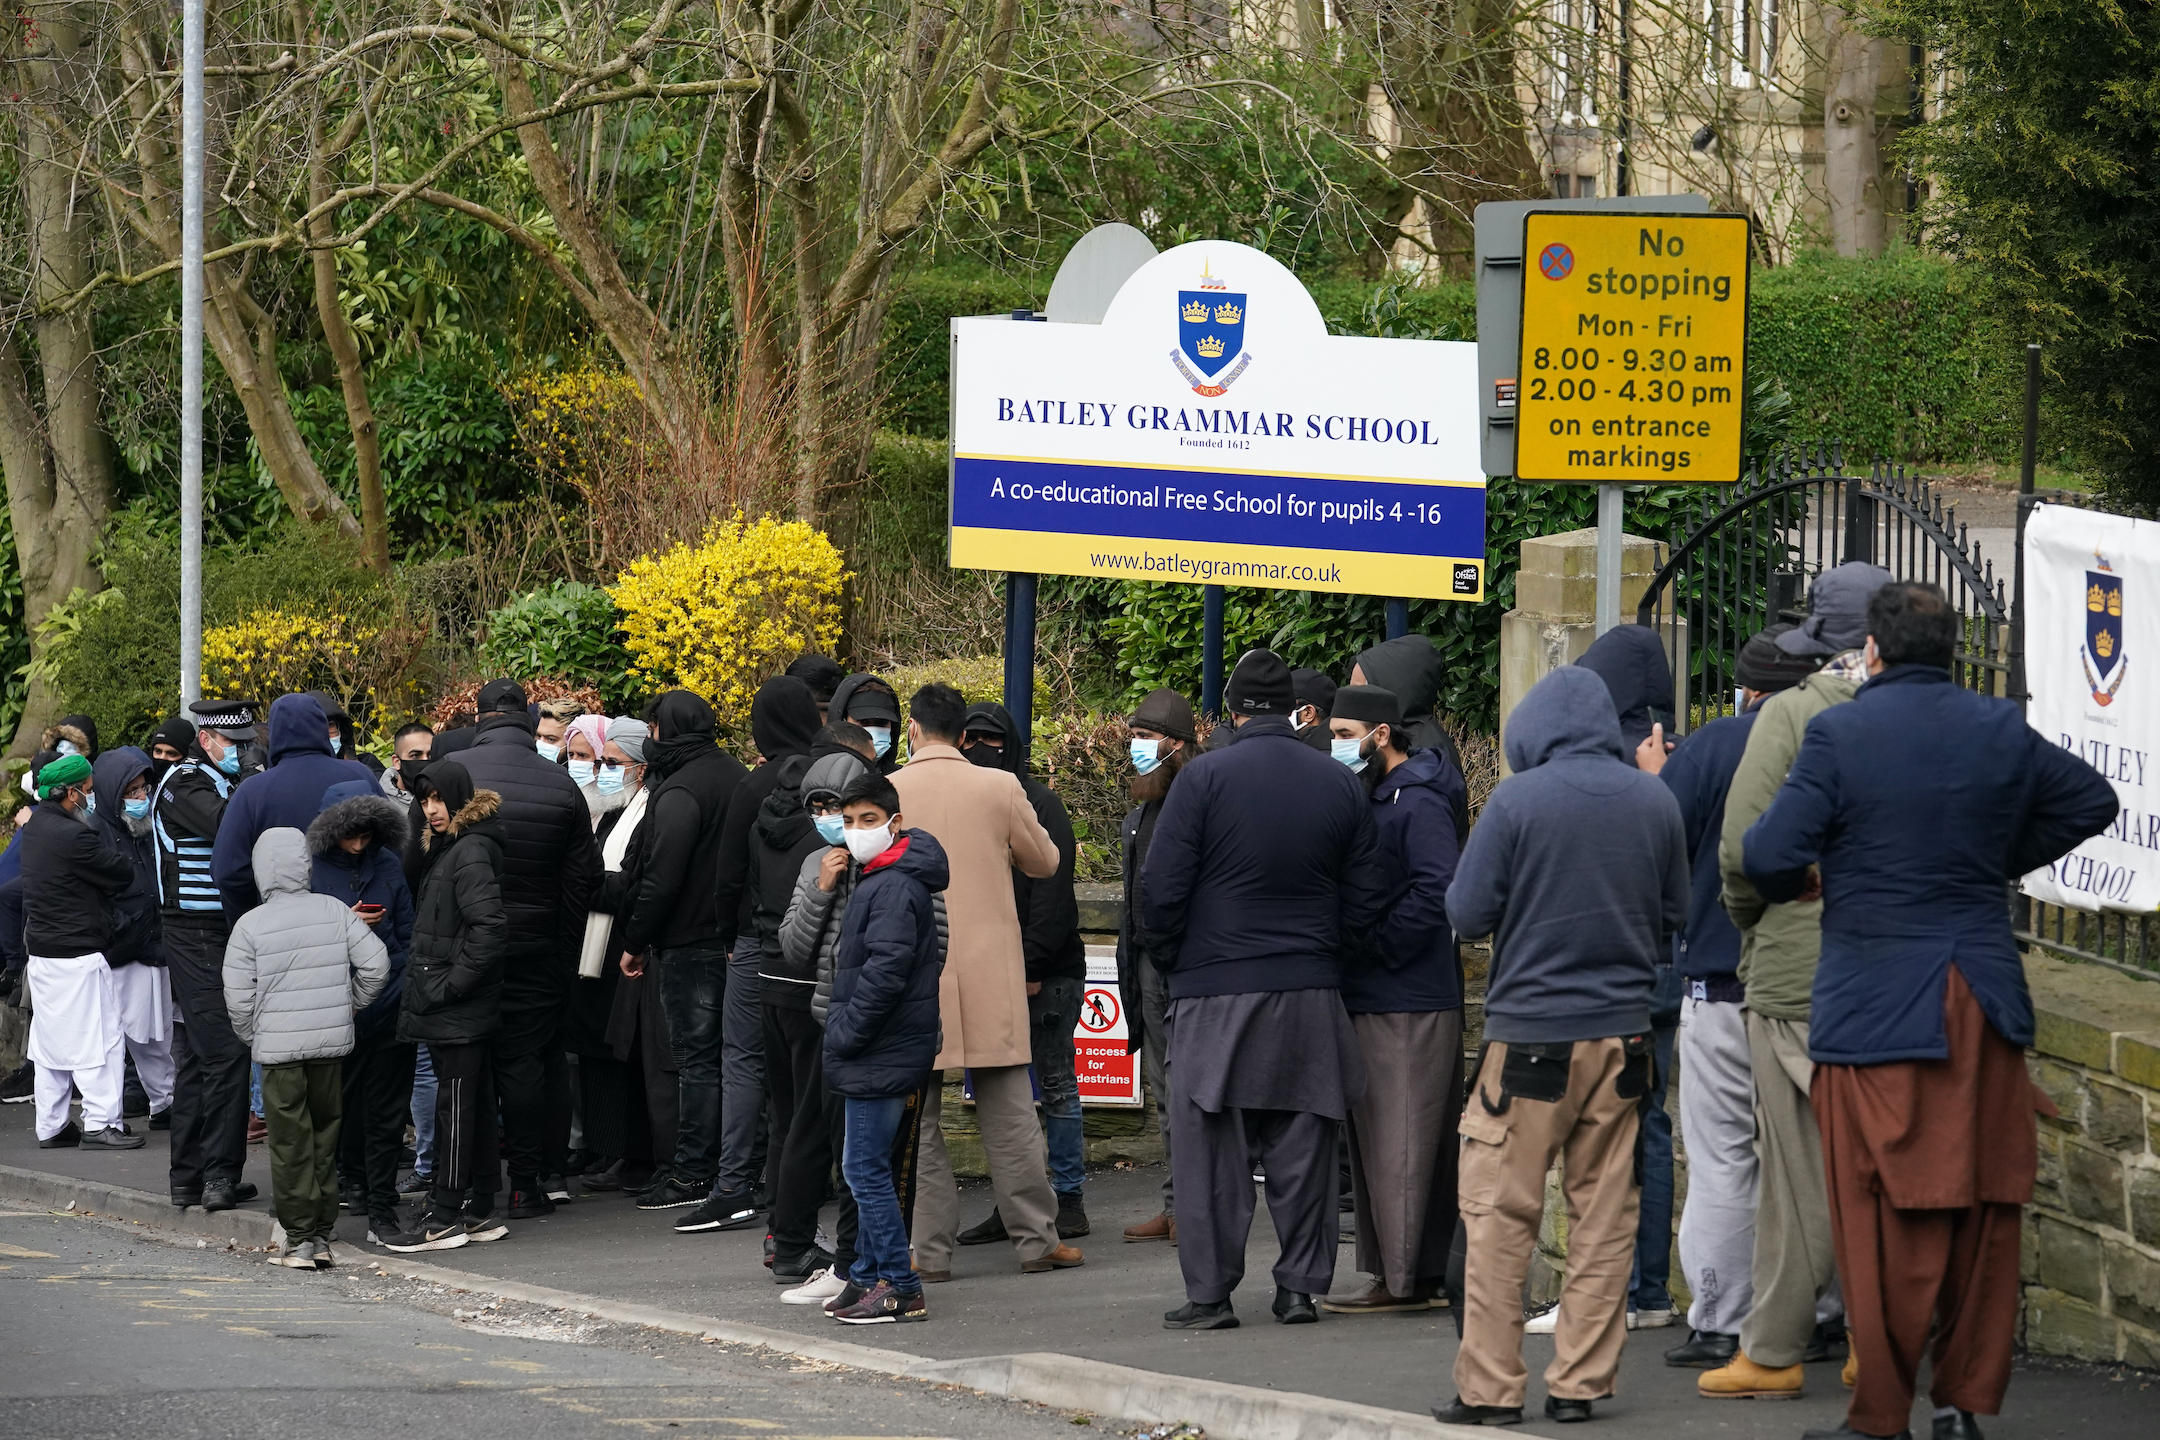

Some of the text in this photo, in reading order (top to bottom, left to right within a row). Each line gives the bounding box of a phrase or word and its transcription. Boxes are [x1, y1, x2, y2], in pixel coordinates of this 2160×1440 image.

[1639, 228, 1685, 258] No
[1586, 266, 1731, 302] stopping
[1577, 313, 1634, 337] Mon
[1658, 314, 1692, 338] Fri
[1533, 346, 1600, 371] 8.00
[1622, 348, 1687, 373] 9.30
[1693, 355, 1732, 373] am
[1175, 359, 1247, 396] FORTE NON IGNAVE
[1530, 377, 1596, 402] 2.00
[1618, 379, 1685, 403] 4.30
[1691, 385, 1732, 408] pm
[997, 397, 1440, 446] BATLEY GRAMMAR SCHOOL
[1549, 414, 1711, 438] on entrance
[1180, 436, 1250, 450] Founded 1612
[1567, 444, 1691, 472] markings
[990, 477, 1006, 499] A
[1009, 479, 1159, 509] co-educational
[1165, 487, 1208, 512] Free
[1212, 489, 1283, 516] School
[1286, 493, 1317, 518] for
[1321, 498, 1385, 526] pupils
[1089, 551, 1341, 584] www.batleygrammar.co.uk
[1455, 571, 1477, 580] Ofsted
[1242, 698, 1271, 710] 24
[1075, 1047, 1127, 1057] o access
[1087, 1059, 1105, 1070] for
[1076, 1073, 1130, 1084] destrians
